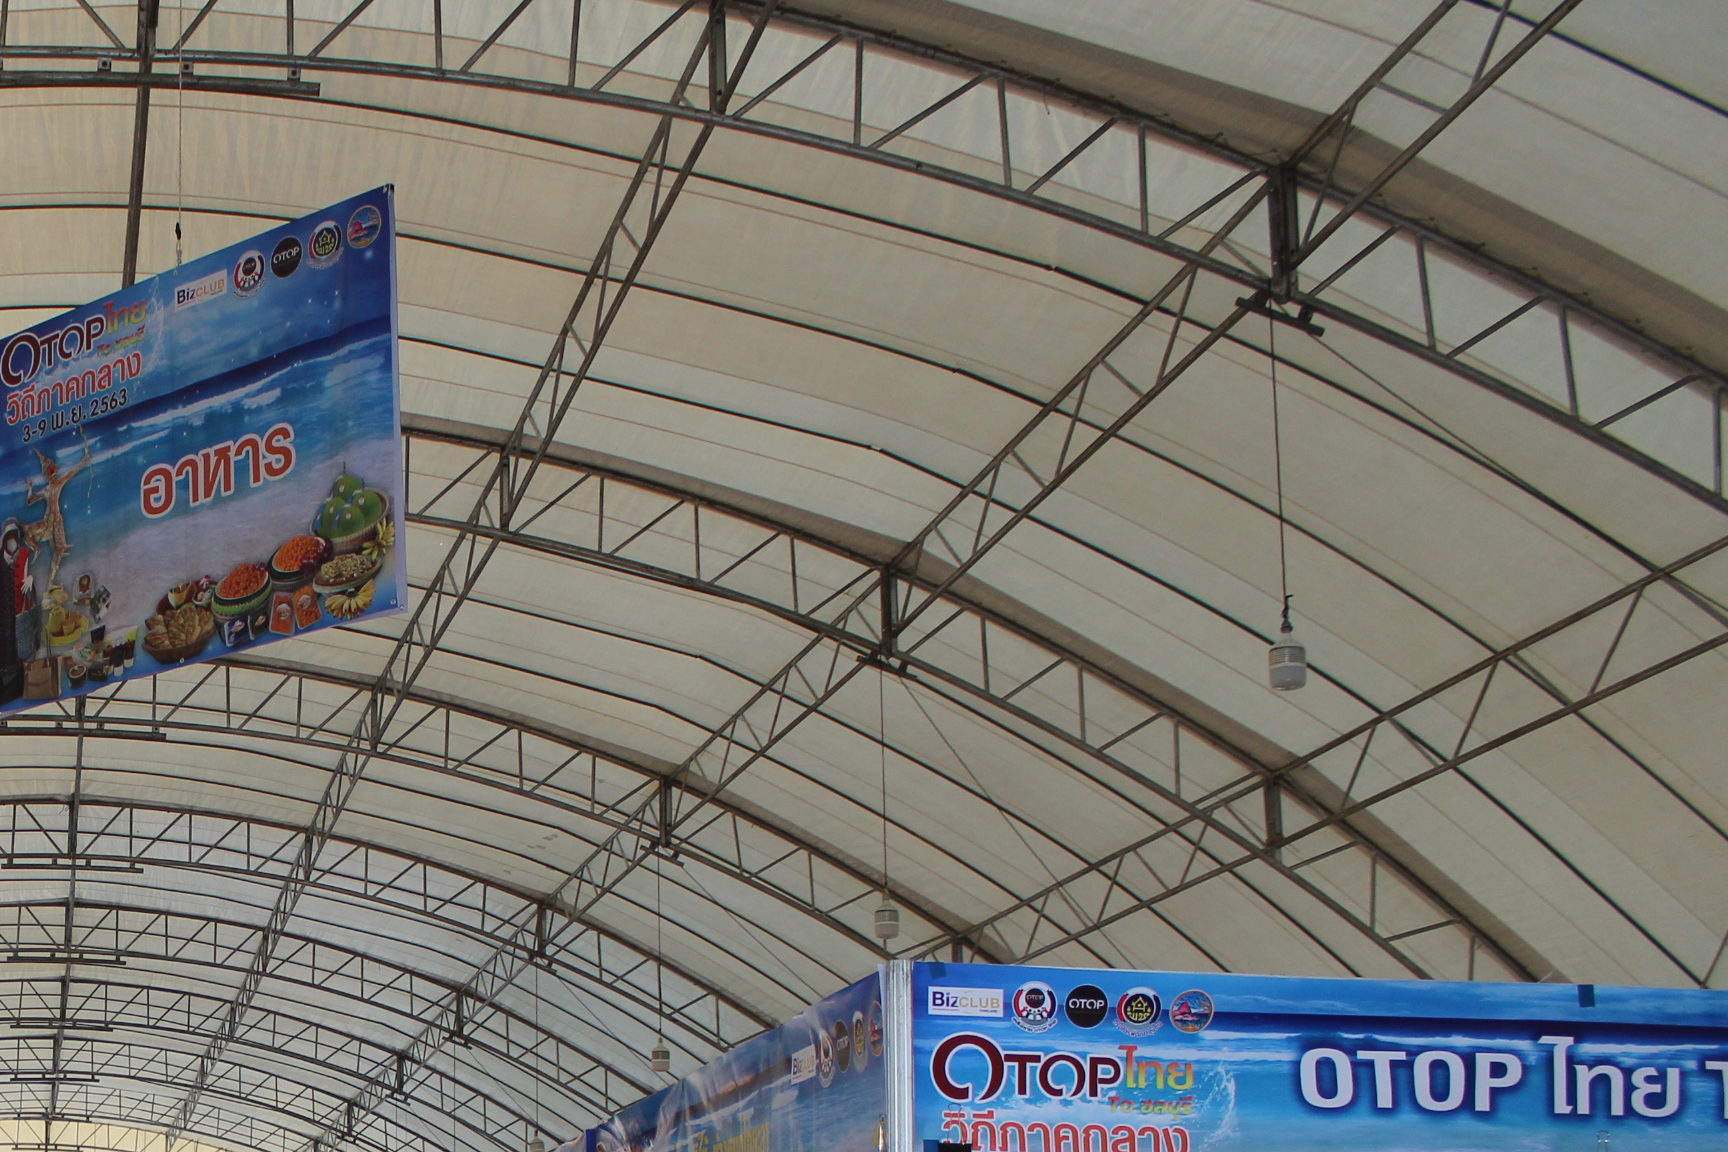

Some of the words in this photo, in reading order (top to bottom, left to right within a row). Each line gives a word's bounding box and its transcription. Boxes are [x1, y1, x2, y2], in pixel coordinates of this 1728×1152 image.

[273, 247, 300, 264] OTOP
[176, 278, 225, 305] BizCLUB
[0, 314, 106, 387] OTOP
[103, 299, 147, 335] ไทย
[6, 351, 143, 425] วิถีภาคกลาง
[22, 419, 47, 443] 3-9
[51, 404, 87, 433] พ.ย.
[90, 388, 128, 418] 2563
[140, 421, 297, 520] อาหาร
[931, 991, 1001, 1009] BizCLUB
[1068, 998, 1105, 1010] OTOP
[930, 1031, 1122, 1103] OTOP
[1118, 1045, 1194, 1091] ไทย
[1299, 1046, 1524, 1113] OTOP
[1537, 1035, 1681, 1118] ไทย
